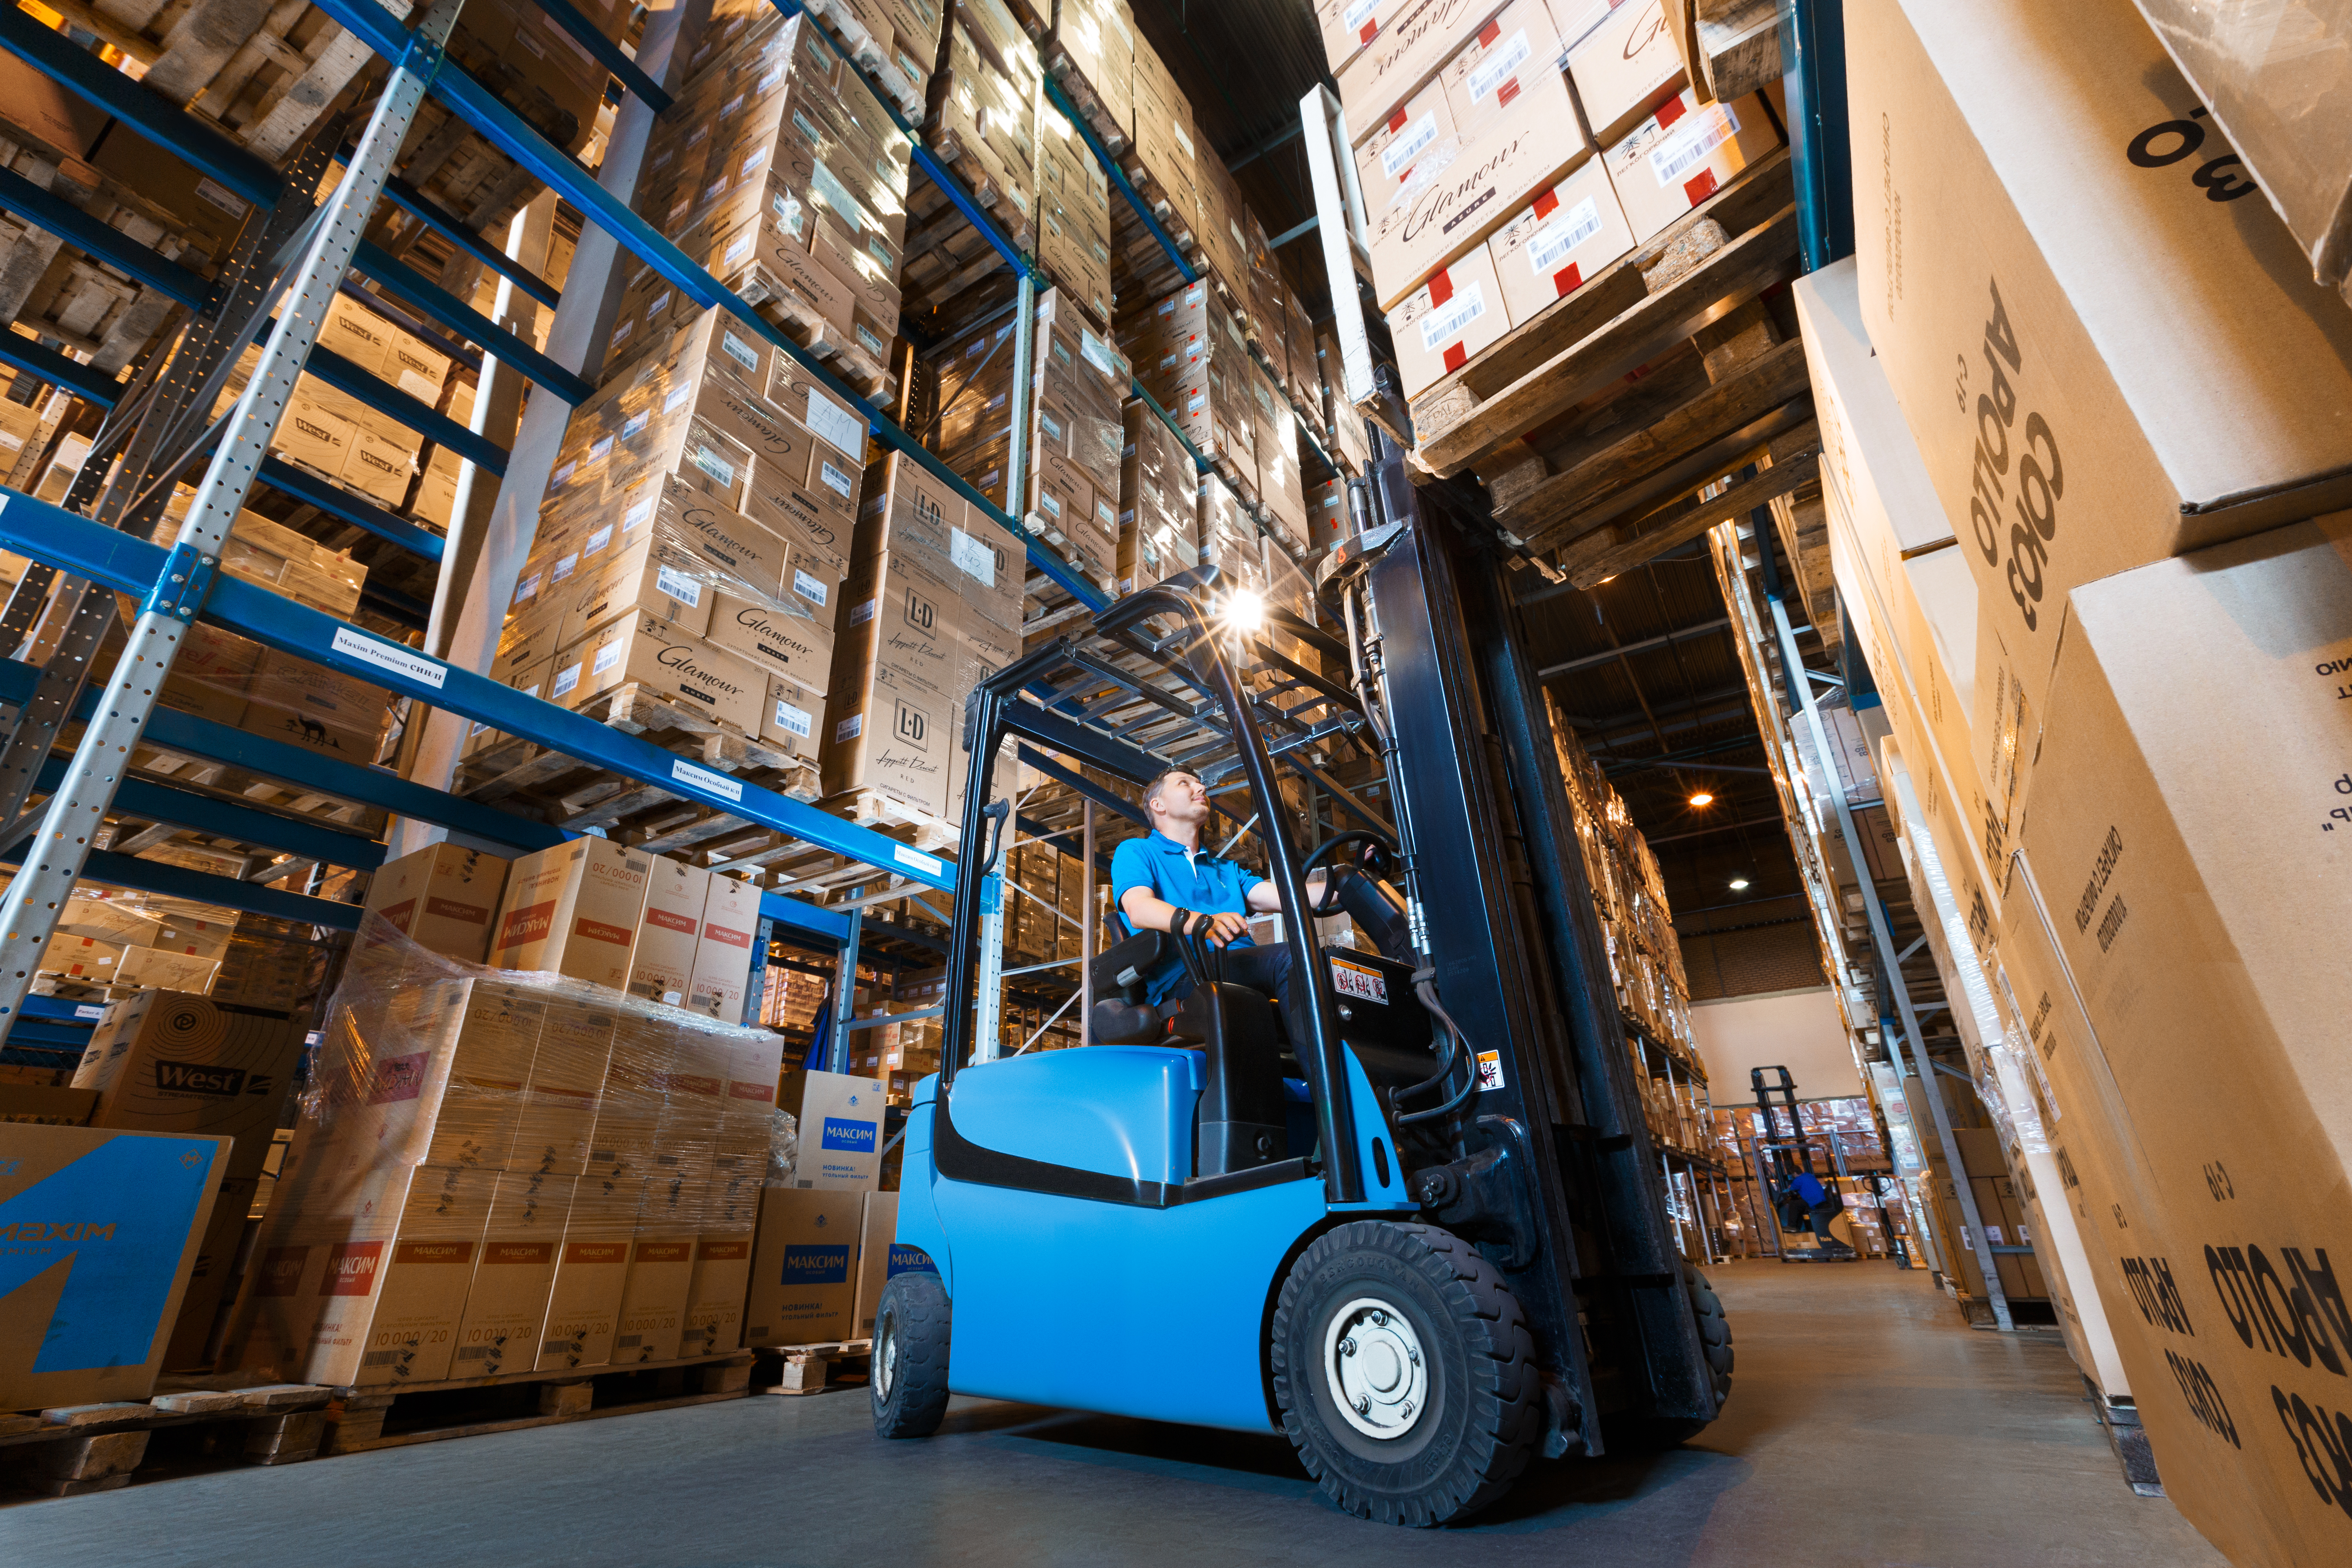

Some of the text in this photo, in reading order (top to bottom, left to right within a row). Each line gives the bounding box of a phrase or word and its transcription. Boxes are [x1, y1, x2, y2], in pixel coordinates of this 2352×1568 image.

[1616, 128, 1675, 177] ЛЕГКОГОРЮЧИЙ
[1402, 130, 1530, 243] Glamour
[1450, 194, 1489, 227] AZURE
[1403, 241, 1455, 283] СУПЕРТОНКИЕ
[1456, 207, 1497, 240] СИГАРЕТЫ
[1507, 164, 1551, 200] ФИЛЬТРОМ
[1499, 221, 1550, 263] ЛЕГКОГОРЮЧИЙ
[775, 248, 838, 304] Glamour
[1049, 245, 1081, 283] Glamour
[1072, 247, 1104, 281] Glamour
[339, 317, 369, 339] West
[1396, 304, 1434, 336] ЛЕГКОГОРЮЧ
[399, 352, 428, 374] West
[297, 418, 329, 441] West
[721, 399, 791, 454] Glamour
[821, 404, 851, 434] AM
[1971, 273, 2022, 568] APOLLO
[361, 448, 392, 473] West
[1050, 456, 1085, 491] Glamour
[769, 496, 835, 545] Glamour
[682, 508, 763, 561] Glamour
[1075, 522, 1109, 555] Glamour
[959, 551, 983, 576] 143
[576, 573, 630, 612] Glamour
[637, 628, 671, 646] ЛЕГКОГОРЮЧИЙ
[736, 608, 813, 655] Glamour
[337, 636, 368, 653] Maxim
[370, 649, 408, 668] Premium
[762, 646, 785, 660] AMBER
[887, 632, 947, 661] Liggett Ducat
[657, 646, 744, 695] Glamour
[727, 642, 760, 662] СУПЕРТОНКИЕ
[761, 657, 785, 672] СИГАРЕТЫ
[789, 672, 813, 686] ФИЛЬТРОМ
[909, 657, 924, 667] RED
[891, 662, 913, 677] СИГАРЕТЫ
[916, 675, 938, 690] ФИЛЬТРОМ
[685, 688, 711, 702] AMBER
[875, 749, 939, 774] Liggett Ducat
[675, 764, 703, 782] Максим
[703, 775, 730, 792] Особый
[900, 774, 915, 783] RED
[880, 783, 902, 795] СИГАРЕТЫ
[906, 793, 930, 807] ФИЛЬТРОМ
[2096, 824, 2123, 888] СИГАРЕТ
[441, 904, 476, 917] МАКСИМ
[657, 914, 687, 927] МАКСИМ
[503, 915, 550, 940] МАКСИМ
[588, 927, 620, 940] МАКСИМ
[715, 929, 741, 941] МАКСИМ
[636, 970, 645, 980] 10
[697, 983, 705, 993] 10
[162, 1065, 236, 1092] West
[738, 1085, 765, 1095] МАКСИМ
[827, 1126, 873, 1140] МАКСИМ
[413, 1247, 457, 1255] МАКСИМ
[499, 1248, 539, 1256] МАКСИМ
[579, 1248, 615, 1256] МАКСИМ
[787, 1255, 845, 1270] МАКСИМ
[327, 1256, 376, 1275] МАКСИМ
[782, 1302, 823, 1312] НОВИНКА!
[2120, 1256, 2195, 1337] APOLLO
[688, 1316, 698, 1326] 10
[781, 1312, 814, 1320] УГОЛЬНЫЙ
[2204, 1243, 2352, 1377] APOLLO
[467, 1329, 481, 1343] 10
[551, 1325, 563, 1337] 10
[624, 1320, 634, 1331] 10
[375, 1333, 389, 1346] 10
